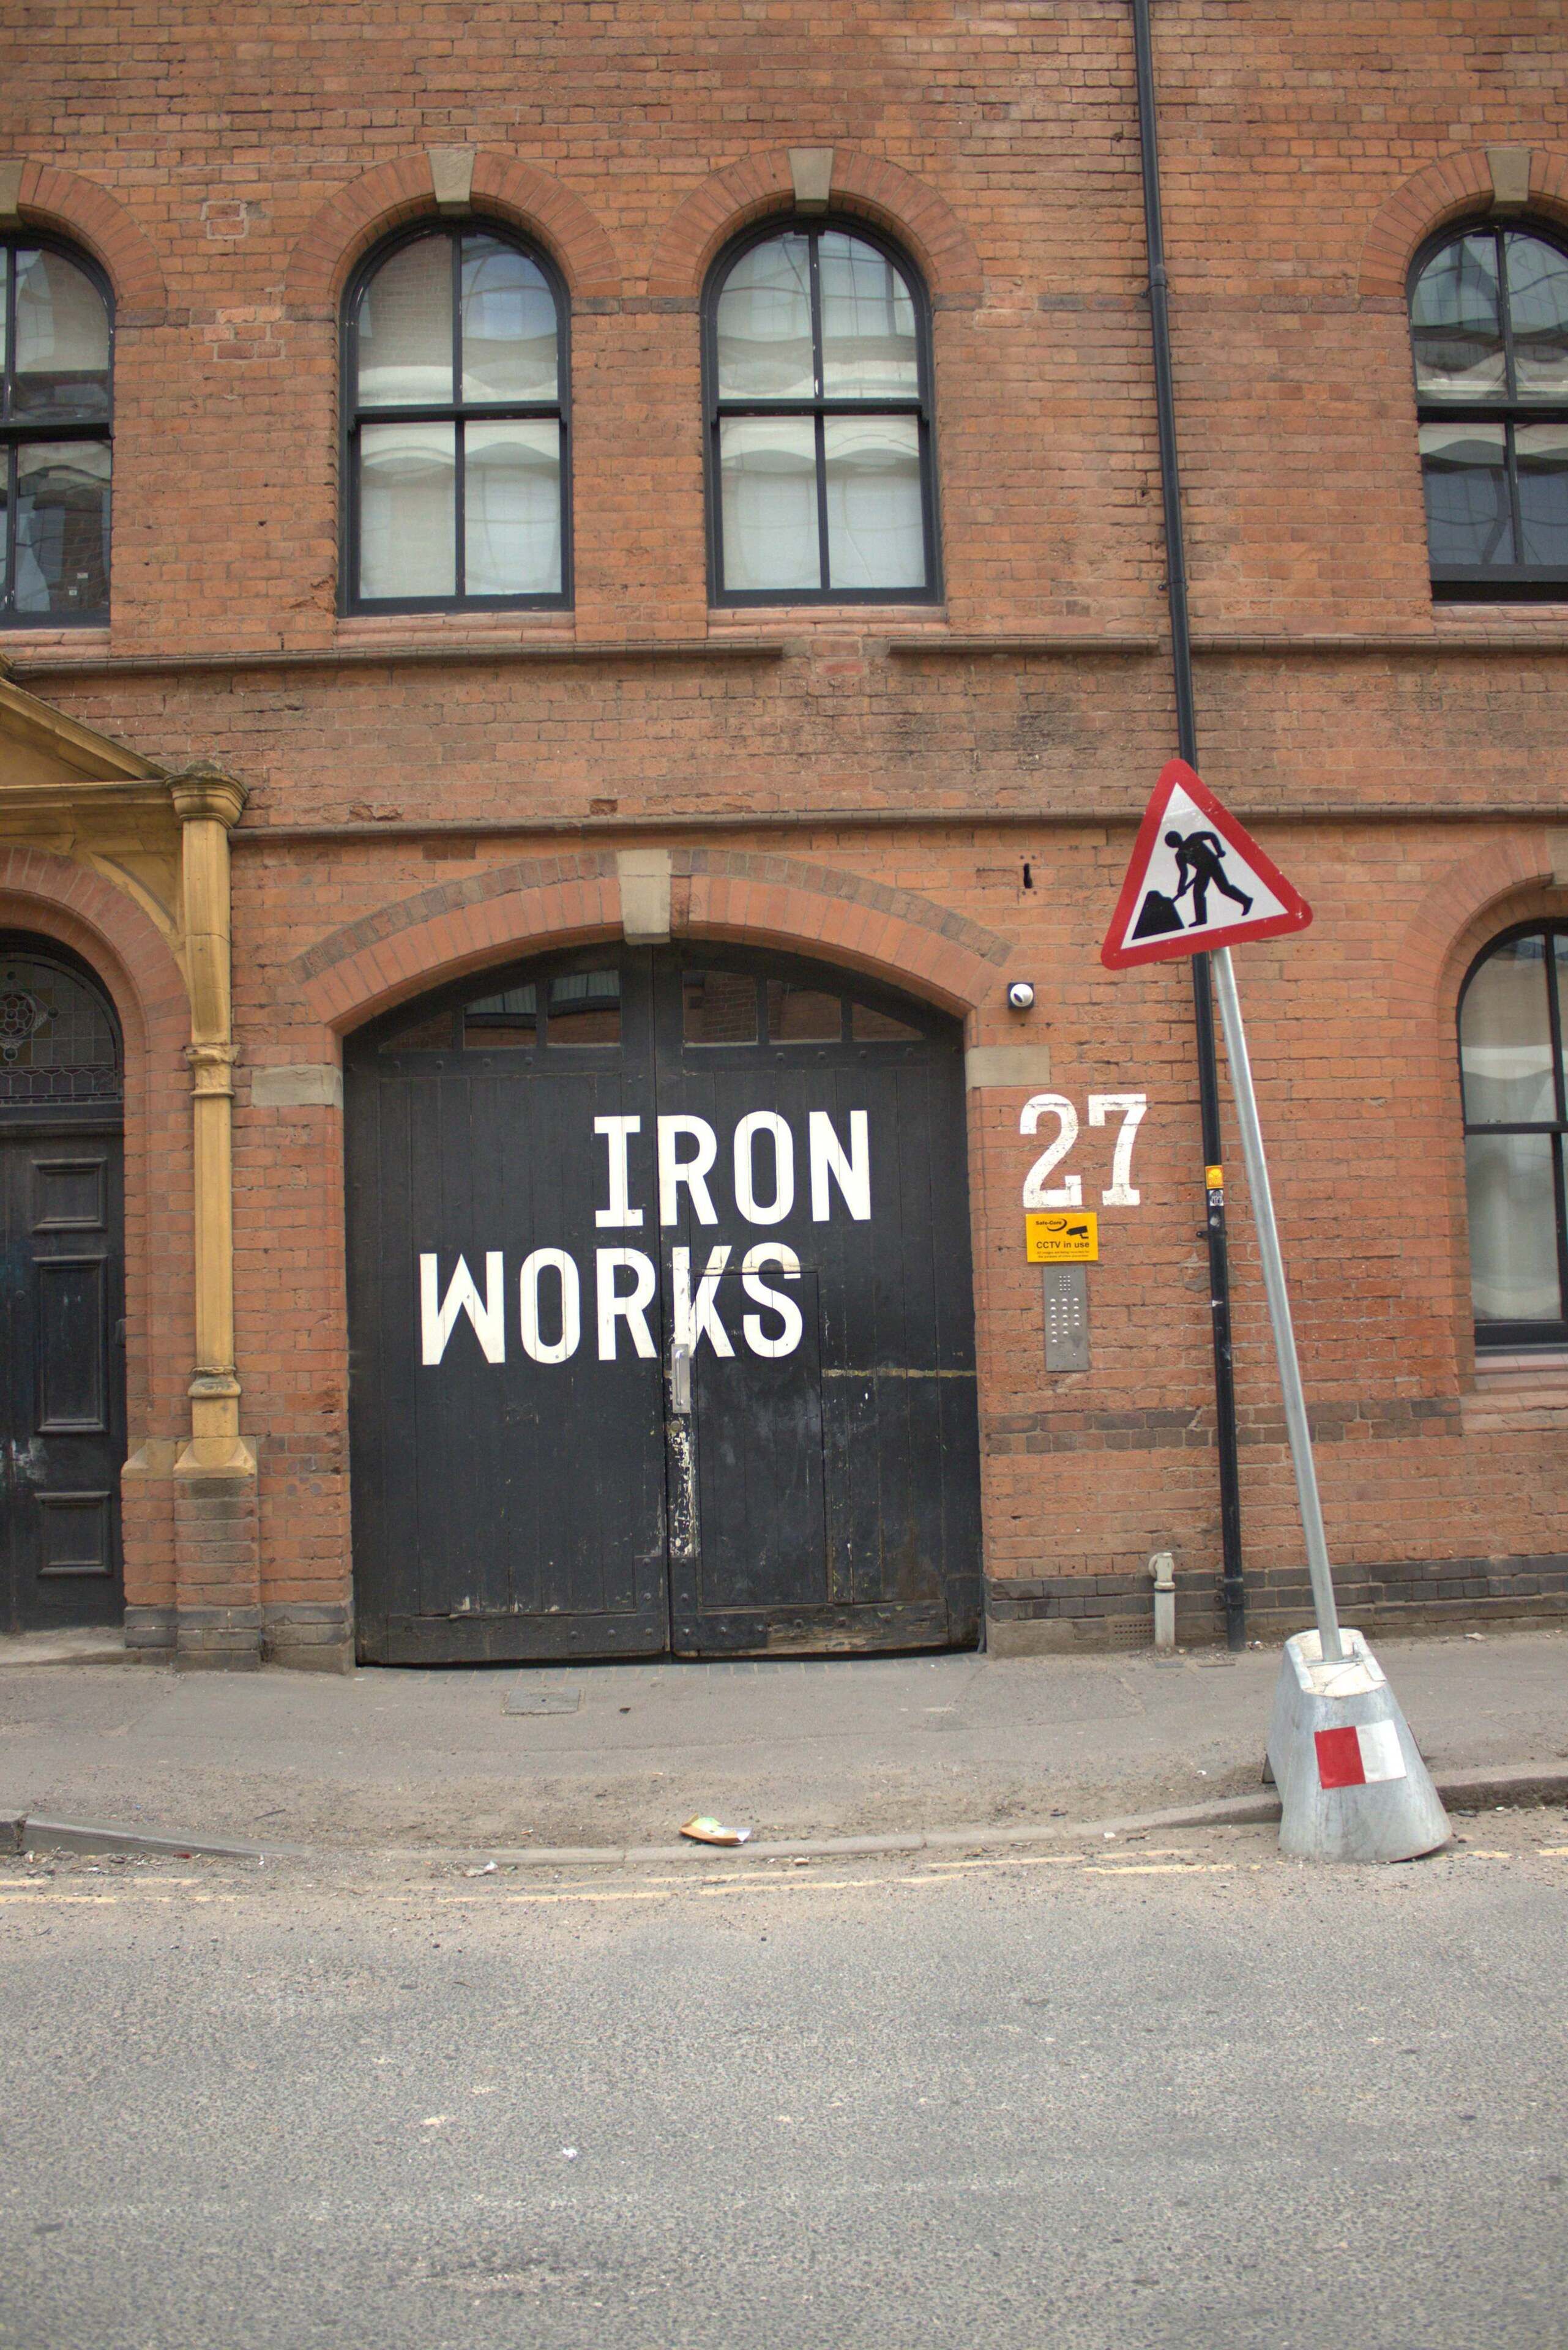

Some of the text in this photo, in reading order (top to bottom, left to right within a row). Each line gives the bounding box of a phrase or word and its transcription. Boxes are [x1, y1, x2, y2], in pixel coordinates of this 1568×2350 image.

[594, 1110, 872, 1228] IRON
[1020, 1094, 1147, 1208] 27
[420, 1242, 804, 1365] WORKS
